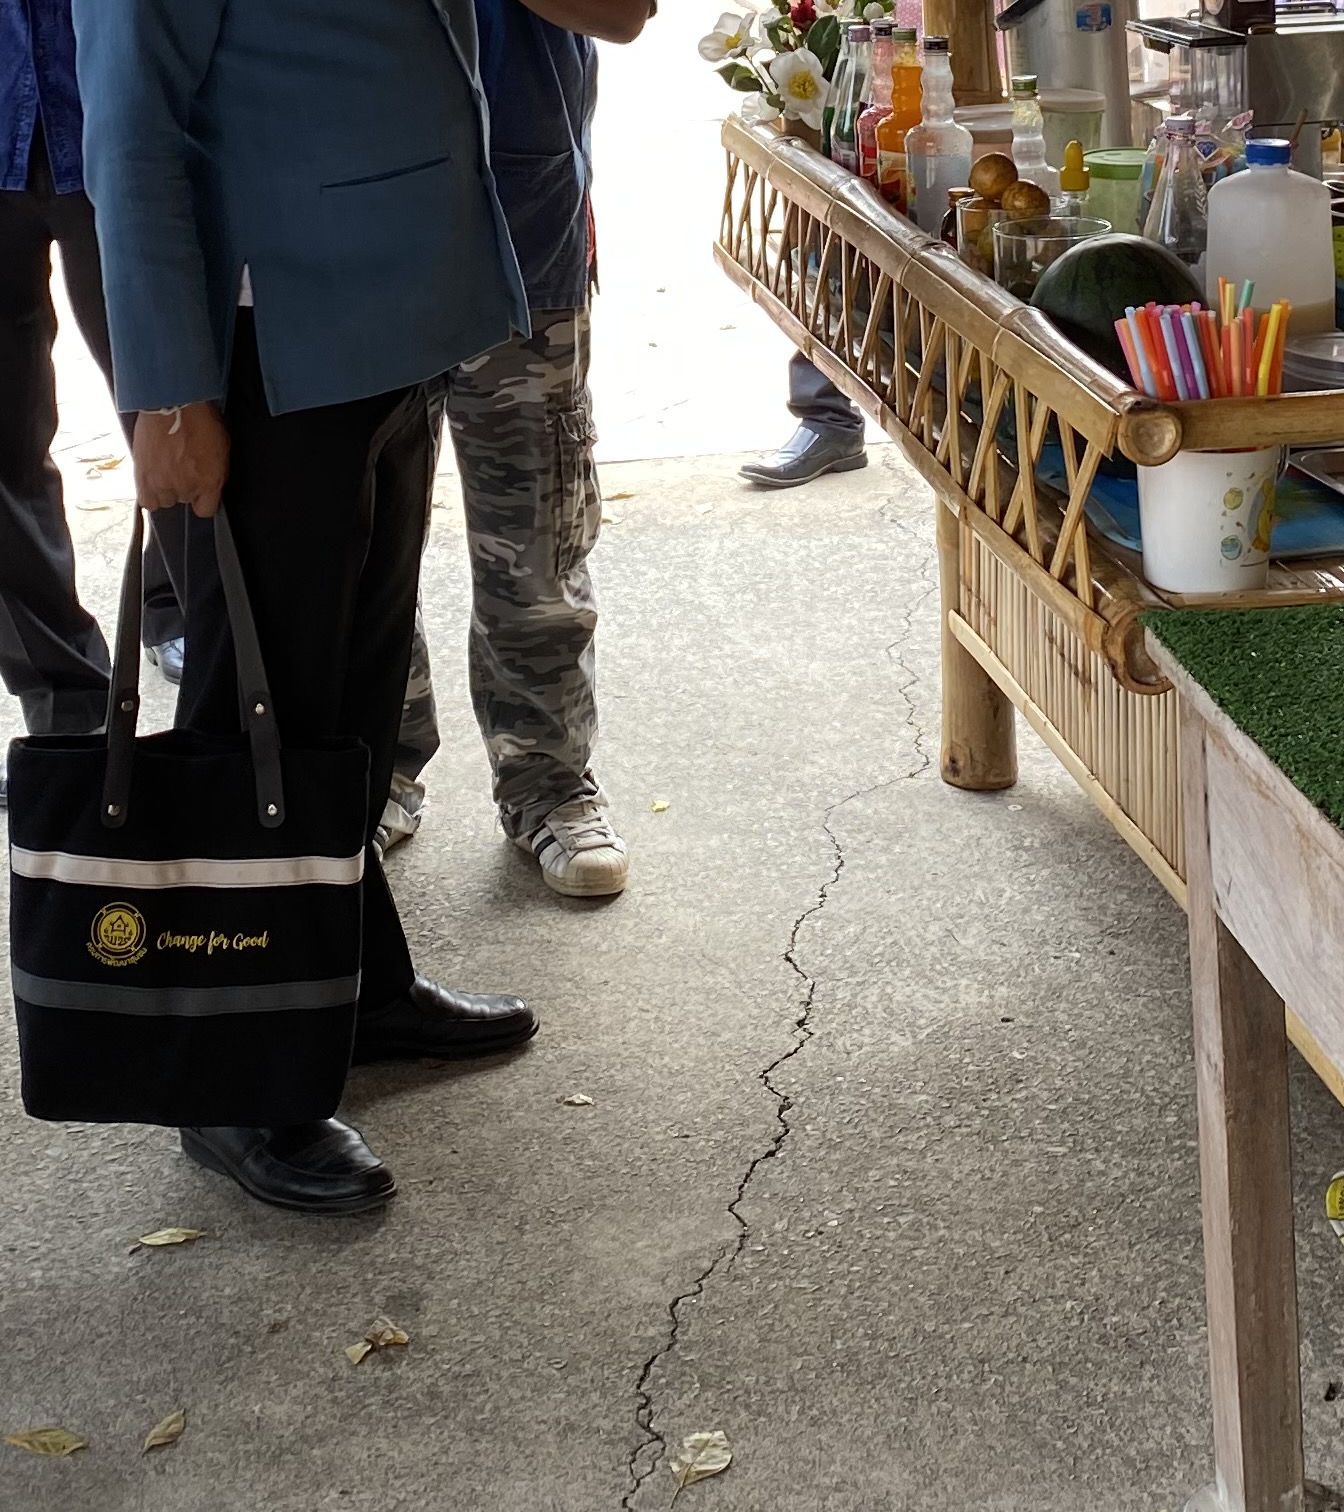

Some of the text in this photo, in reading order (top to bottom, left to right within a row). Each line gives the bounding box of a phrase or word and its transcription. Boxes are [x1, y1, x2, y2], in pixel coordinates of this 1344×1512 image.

[157, 930, 206, 953] Change
[207, 931, 229, 955] for
[233, 931, 269, 950] Good
